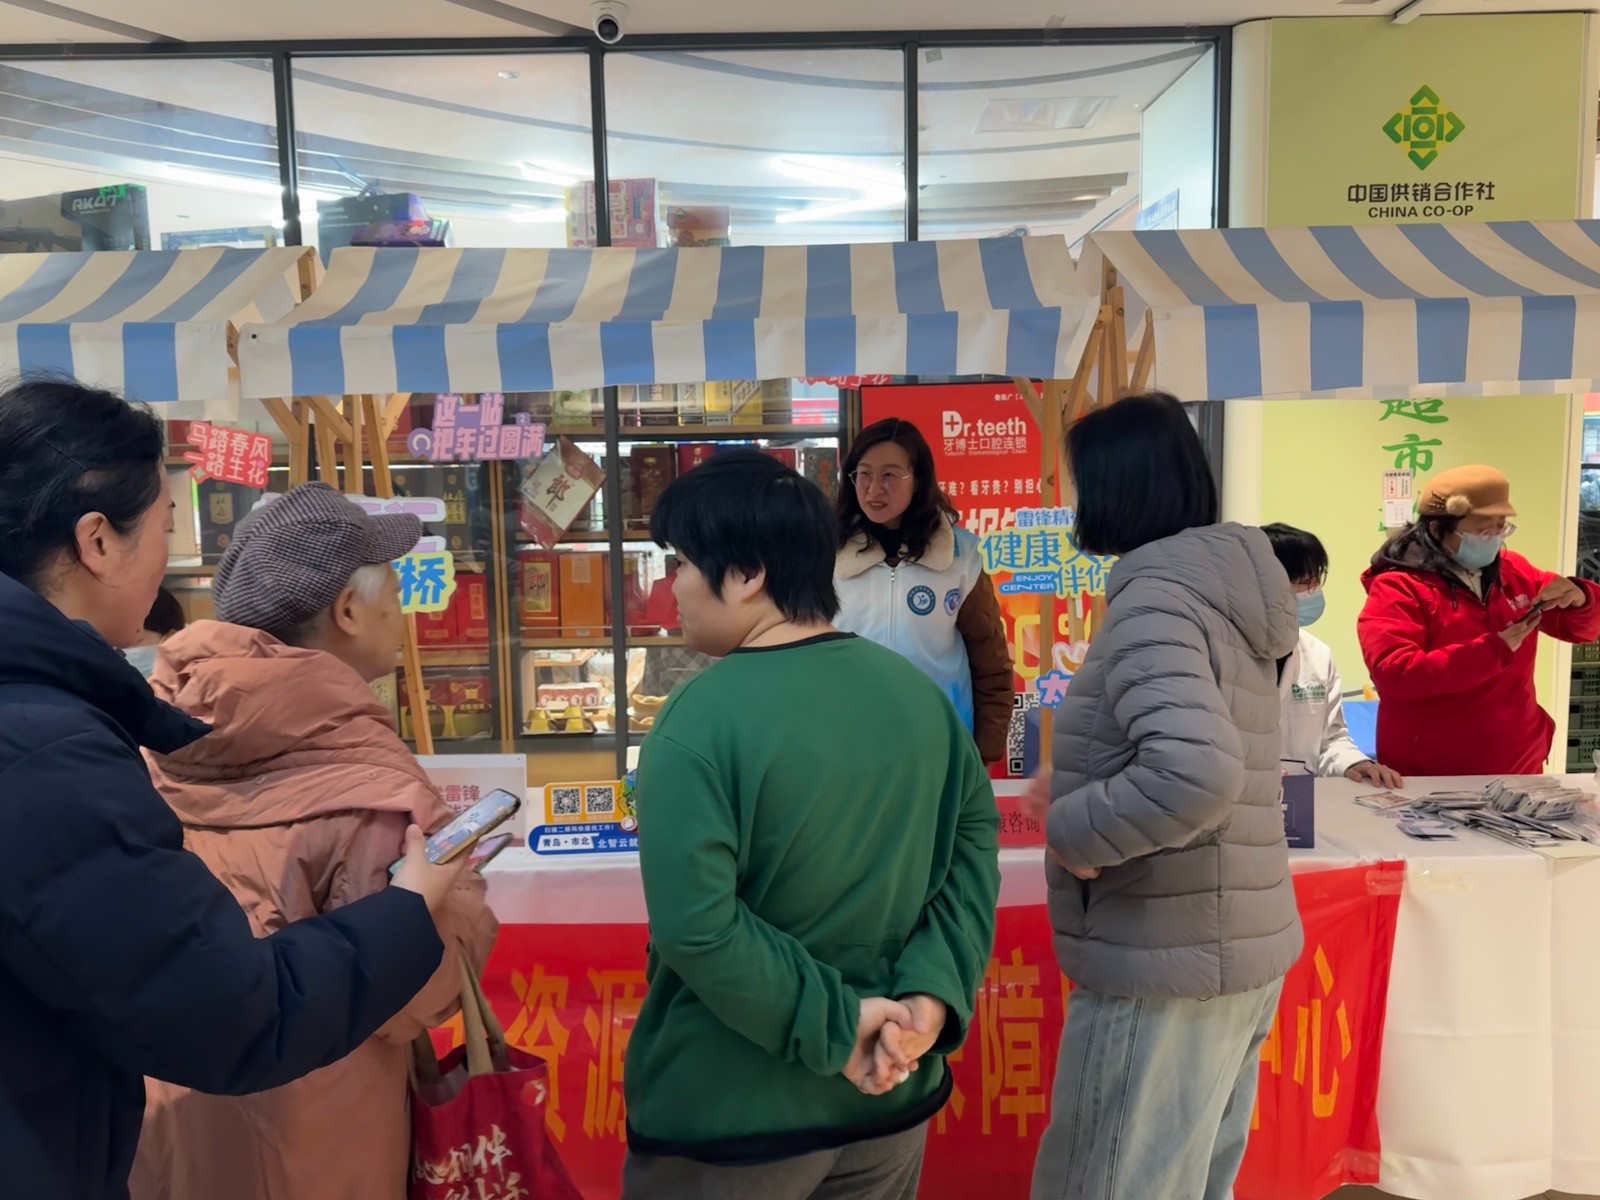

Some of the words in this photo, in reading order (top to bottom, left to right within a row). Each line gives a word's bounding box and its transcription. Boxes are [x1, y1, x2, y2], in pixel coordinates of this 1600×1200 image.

[1348, 181, 1495, 203] 中国供销合作社
[72, 195, 117, 211] AK47
[1368, 206, 1418, 218] CHINA
[1422, 205, 1474, 217] CO-OP
[189, 423, 269, 464] 马踏春风
[943, 437, 1027, 451] 牙博士口腔连锁
[186, 451, 264, 486] 一路生花
[1017, 508, 1076, 528] 雷锋精
[391, 557, 447, 607] 桥
[1001, 583, 1055, 591] CENTER
[1016, 574, 1054, 582] ENJOY
[940, 946, 1046, 1138] 障
